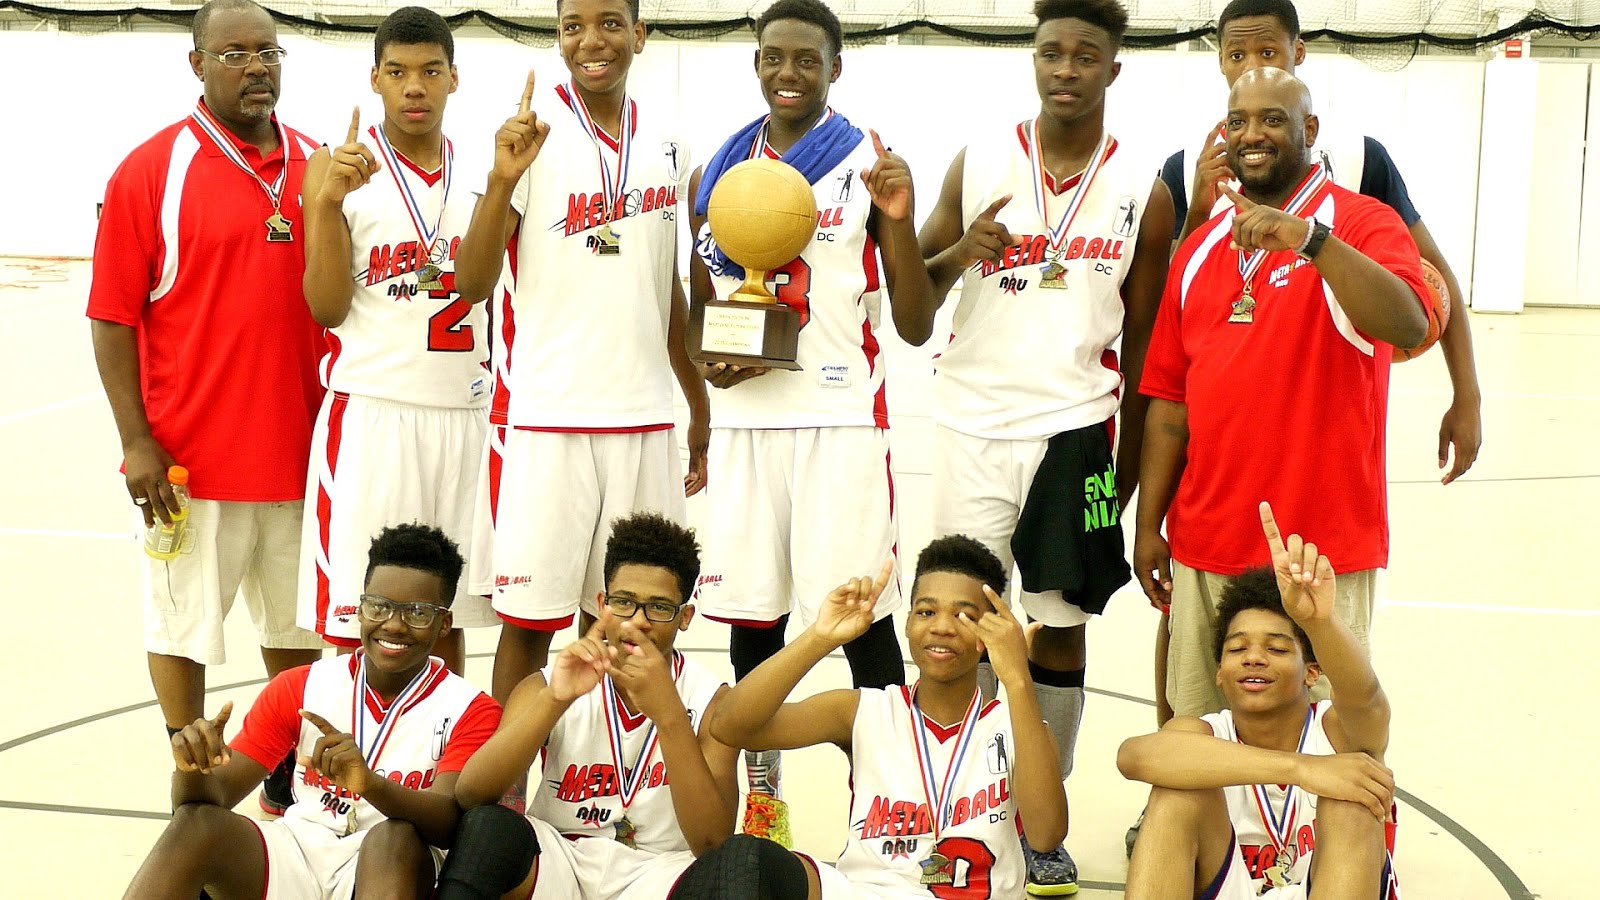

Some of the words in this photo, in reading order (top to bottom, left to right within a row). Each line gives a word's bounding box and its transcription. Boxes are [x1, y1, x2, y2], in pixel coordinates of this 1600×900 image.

[662, 211, 674, 221] DC
[817, 232, 835, 242] DC
[1065, 236, 1123, 260] BALL
[1094, 263, 1113, 275] DC
[999, 276, 1028, 292] AAU
[427, 271, 475, 352] 2
[387, 768, 435, 791] BAL
[320, 792, 351, 815] AAU
[951, 777, 1010, 827] BALL
[575, 806, 612, 823] AAU
[989, 811, 1007, 824] DC
